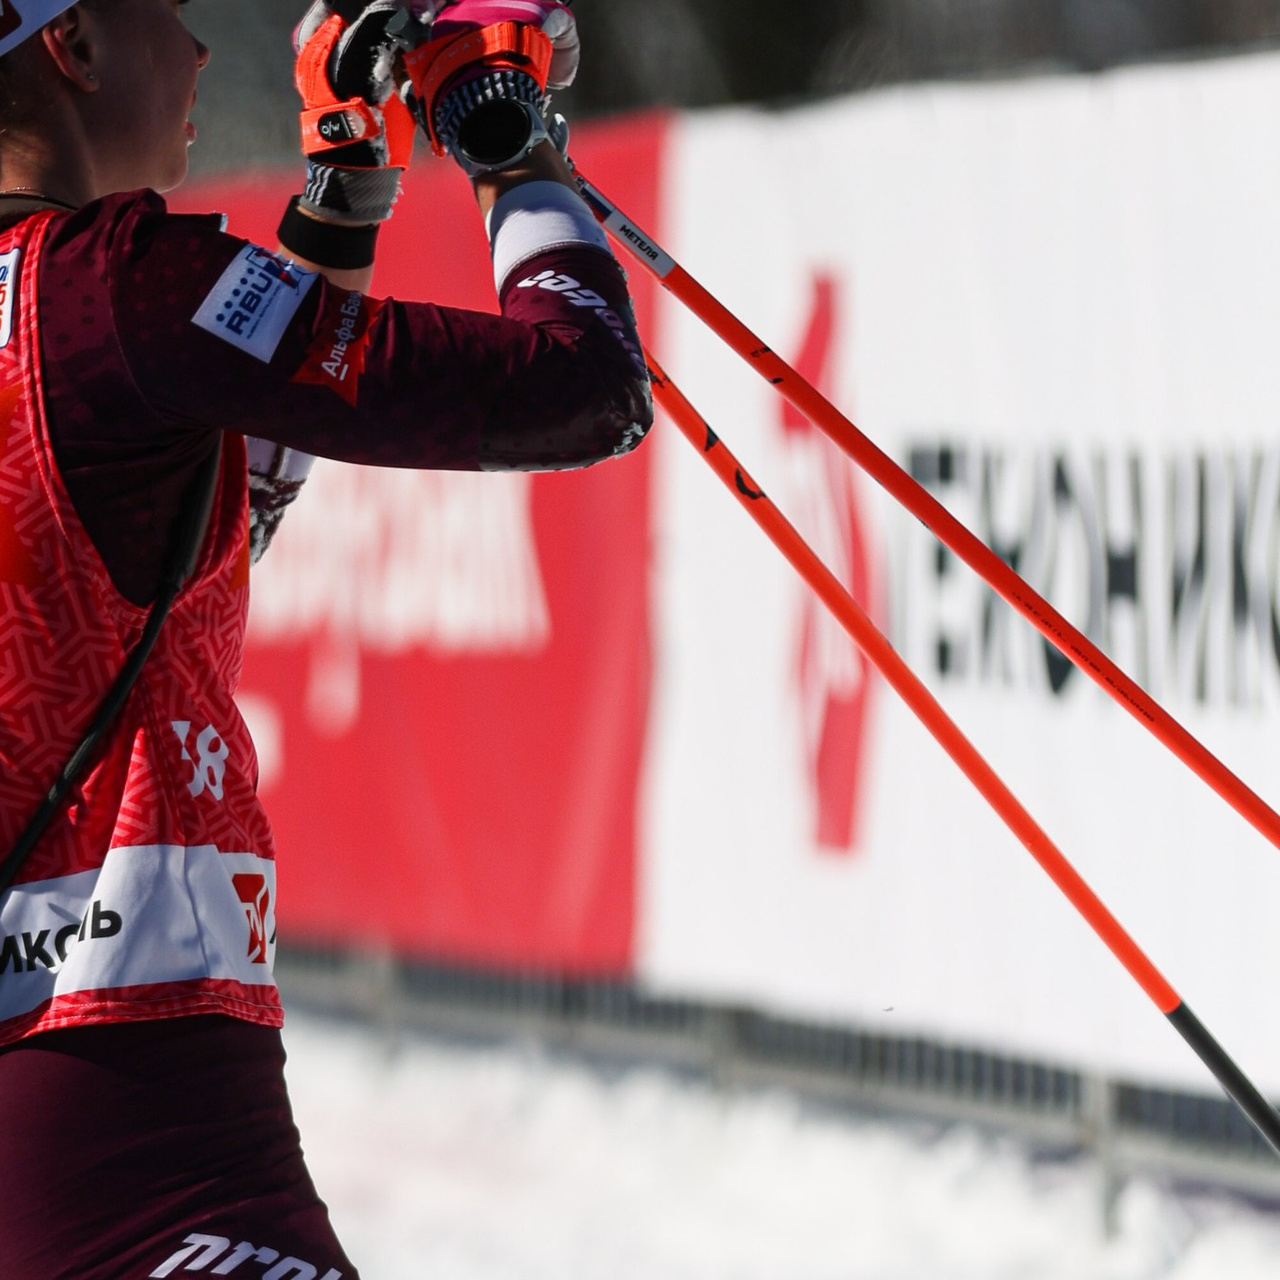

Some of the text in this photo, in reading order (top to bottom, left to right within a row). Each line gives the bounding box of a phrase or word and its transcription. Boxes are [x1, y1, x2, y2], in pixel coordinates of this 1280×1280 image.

[619, 224, 659, 261] МЕТЕЛЯ
[225, 272, 274, 336] RBU
[322, 310, 357, 380] Альфа
